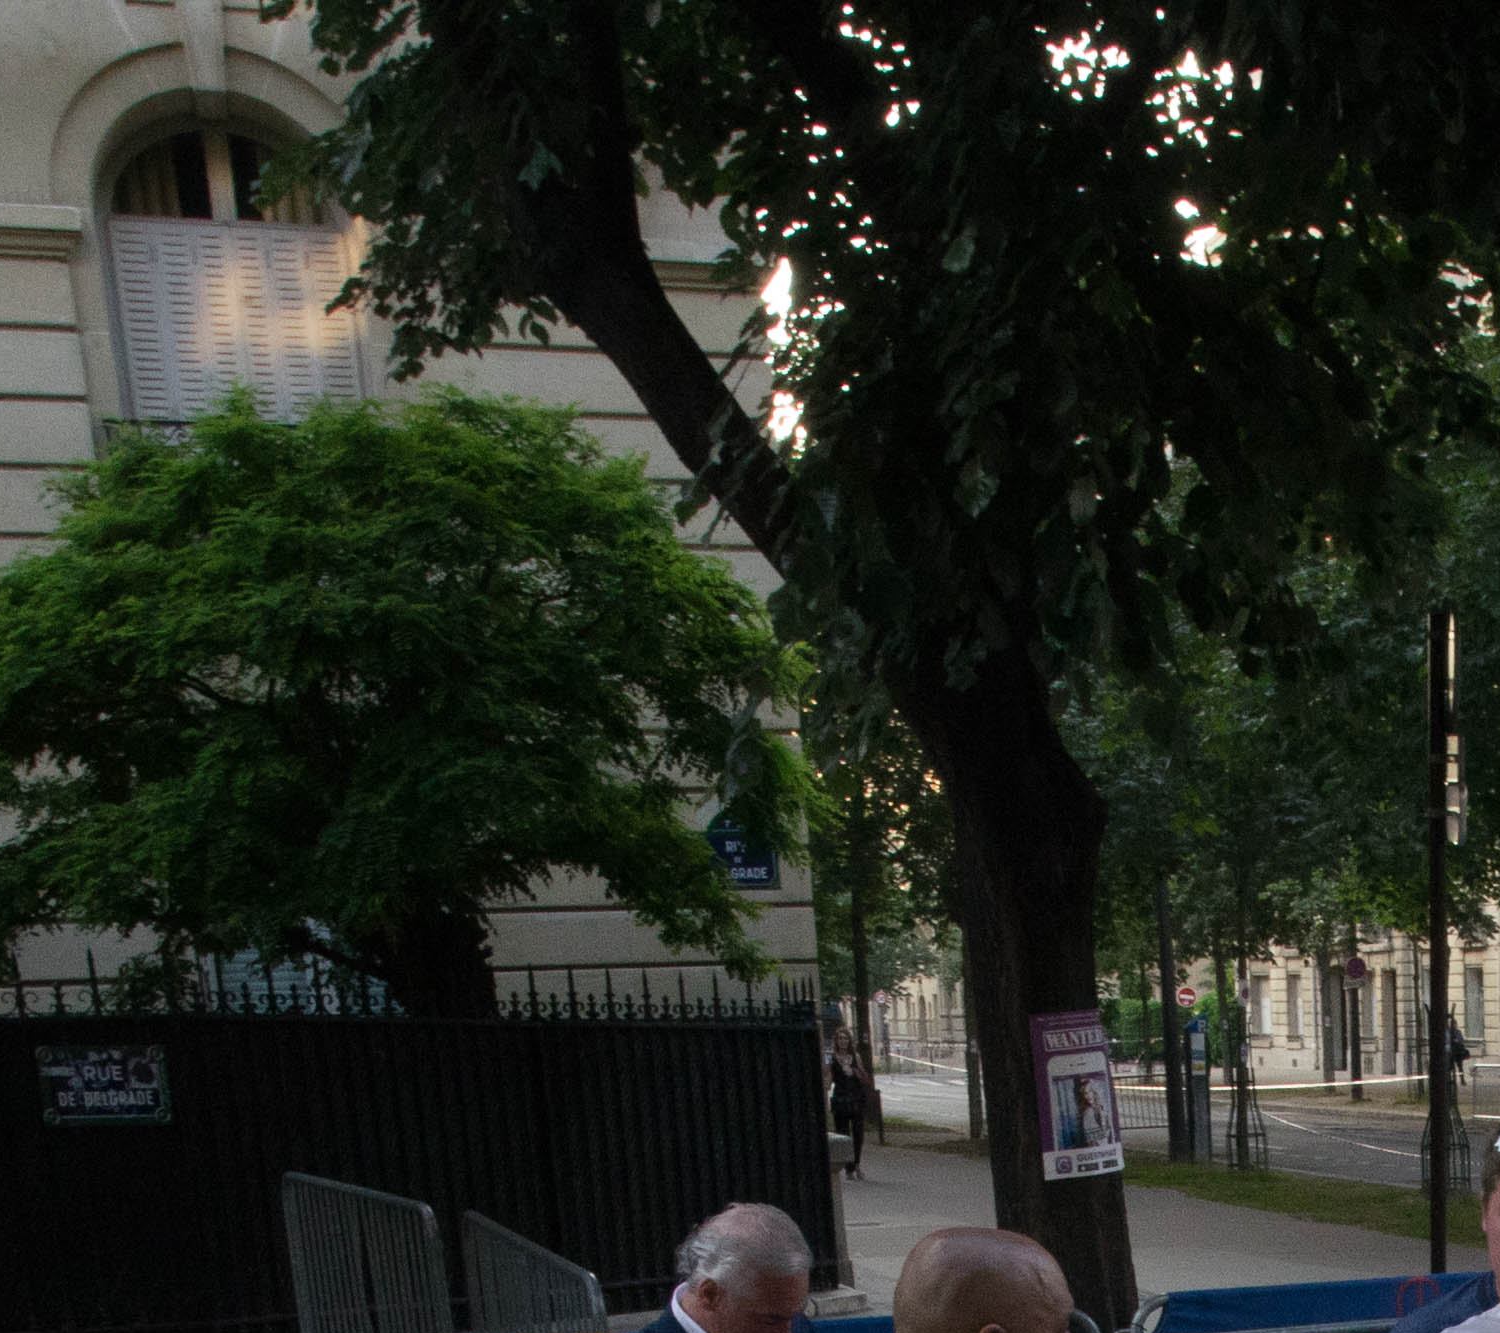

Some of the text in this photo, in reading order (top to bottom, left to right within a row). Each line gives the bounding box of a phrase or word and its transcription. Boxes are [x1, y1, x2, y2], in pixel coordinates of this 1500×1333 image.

[731, 867, 769, 880] GRADE
[82, 1065, 124, 1081] RUE
[56, 1091, 77, 1107] DE
